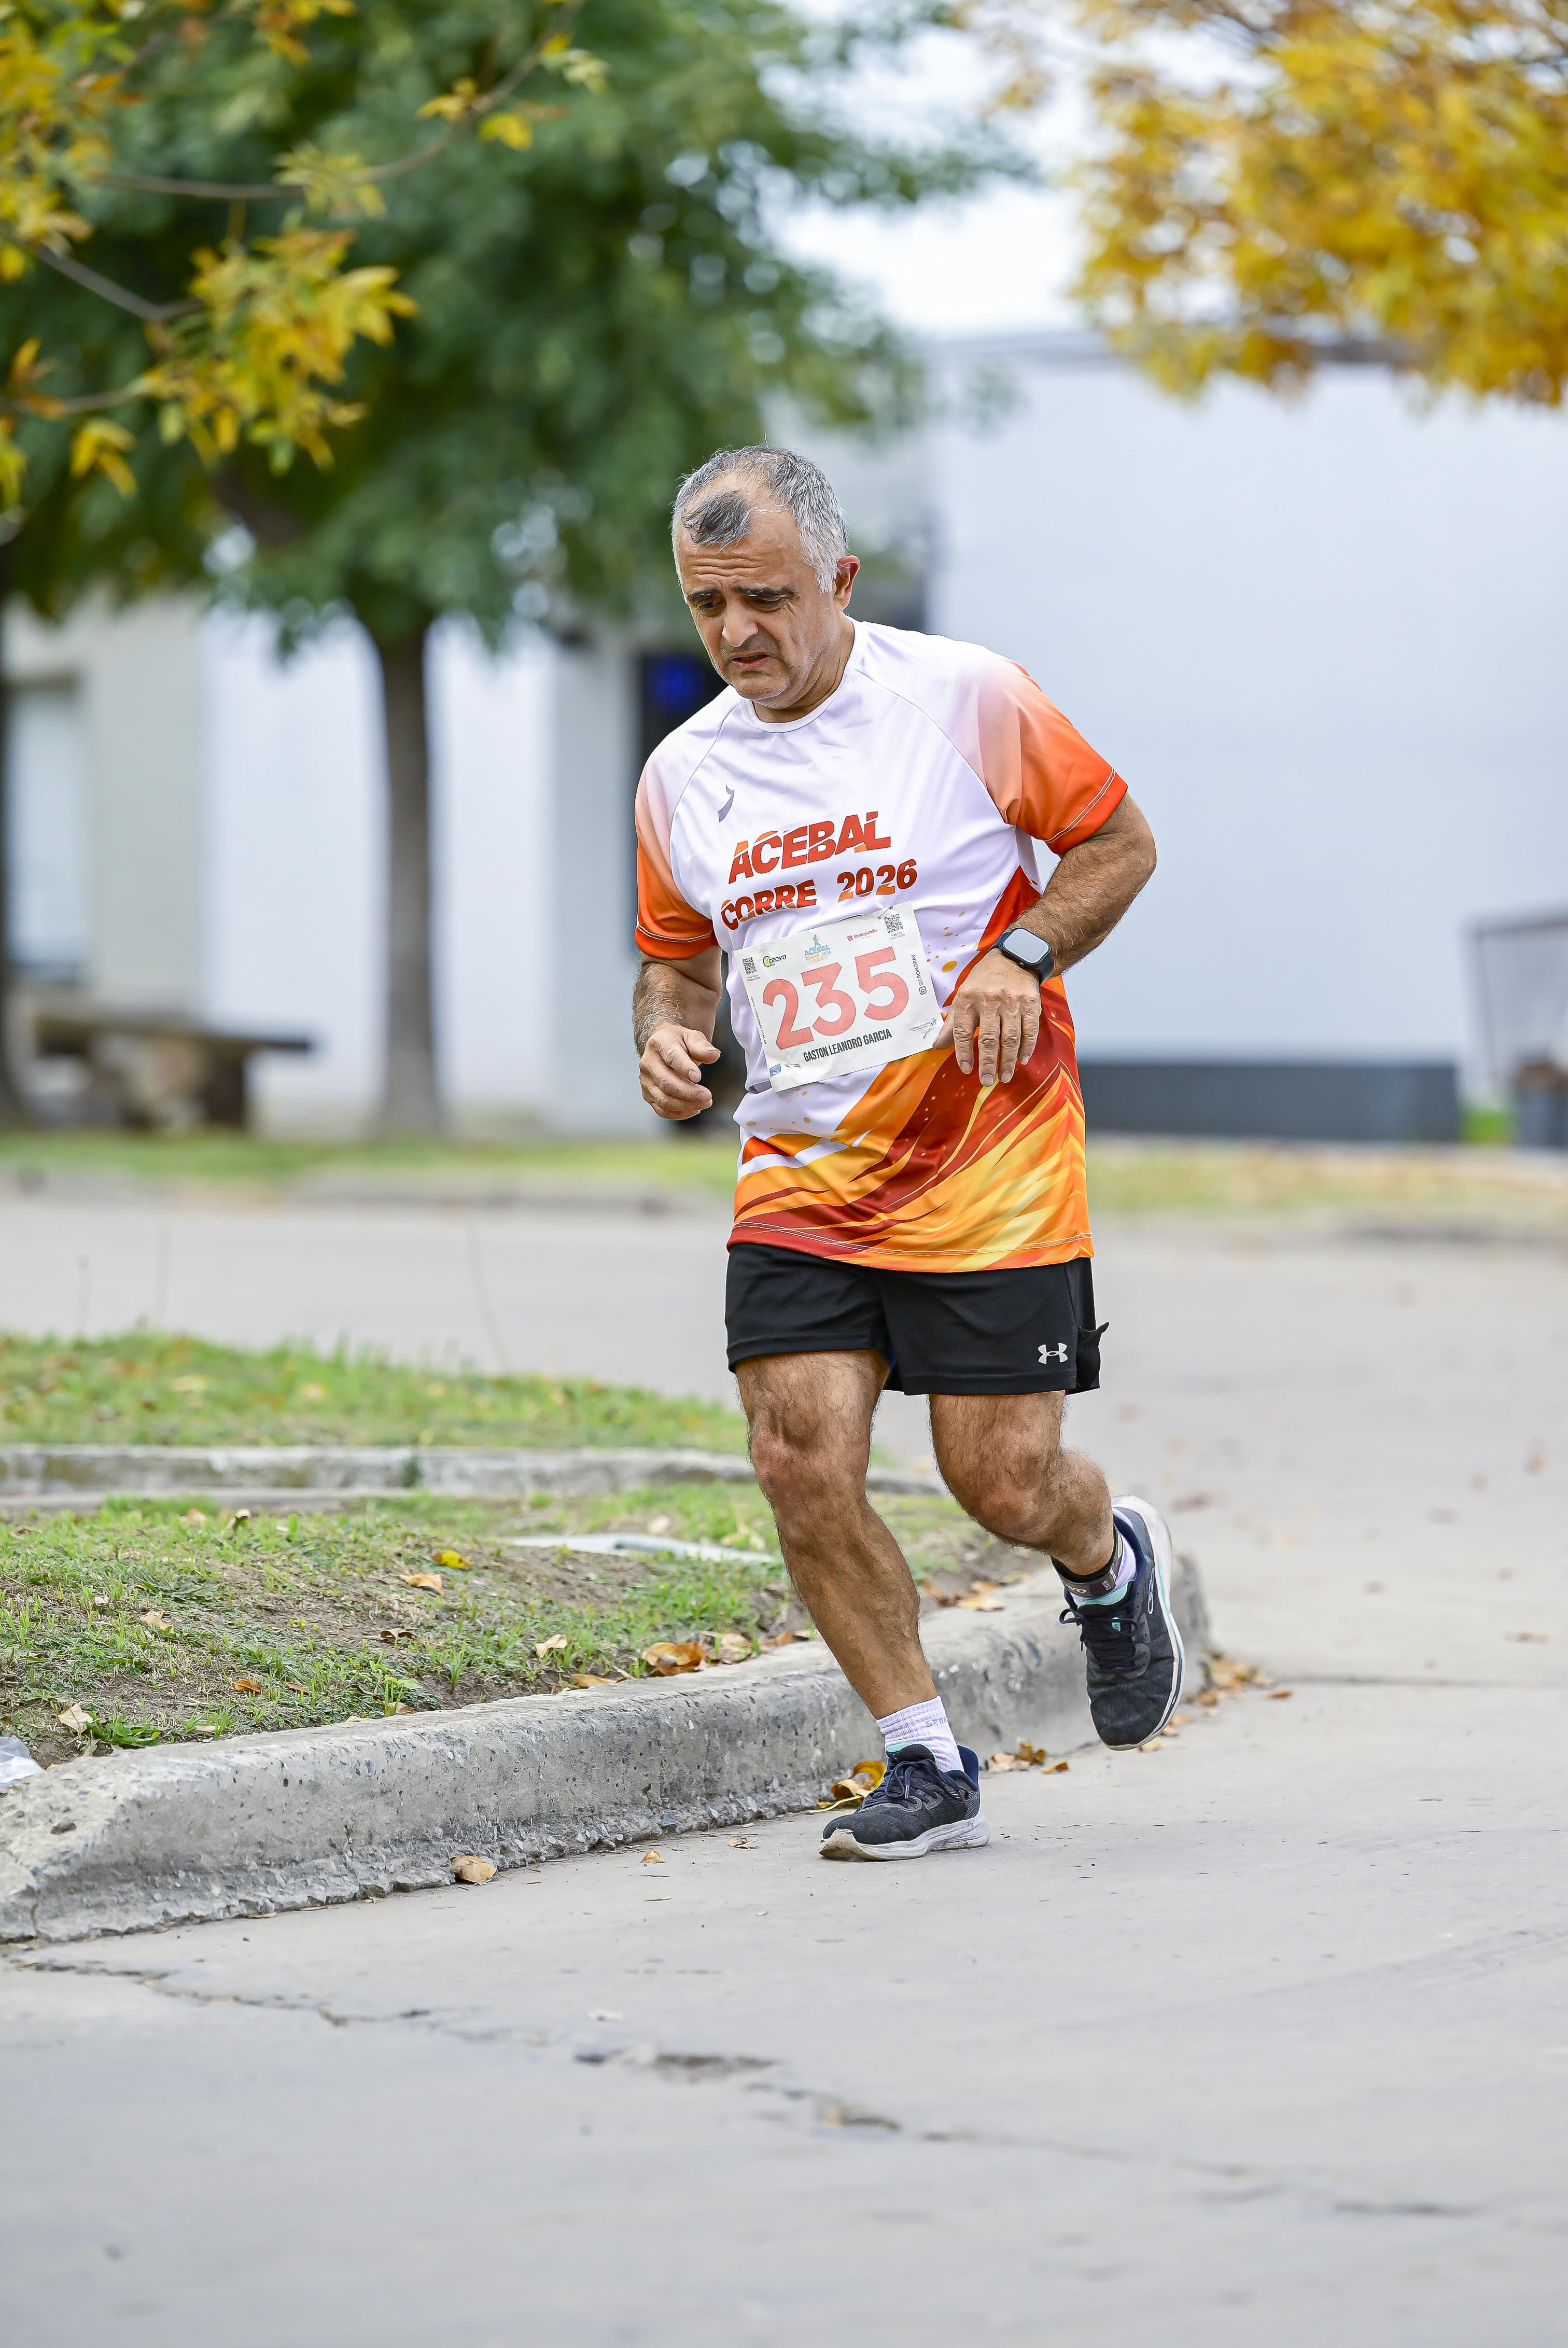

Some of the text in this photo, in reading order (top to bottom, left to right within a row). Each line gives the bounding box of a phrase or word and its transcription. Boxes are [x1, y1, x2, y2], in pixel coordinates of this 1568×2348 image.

[729, 811, 891, 884] ACEBAL
[721, 858, 917, 931] CORRE 2026
[805, 945, 830, 956] ACEBAL
[762, 946, 909, 1050] 235
[803, 1028, 892, 1062] GASTON LEANDRO GARCIA
